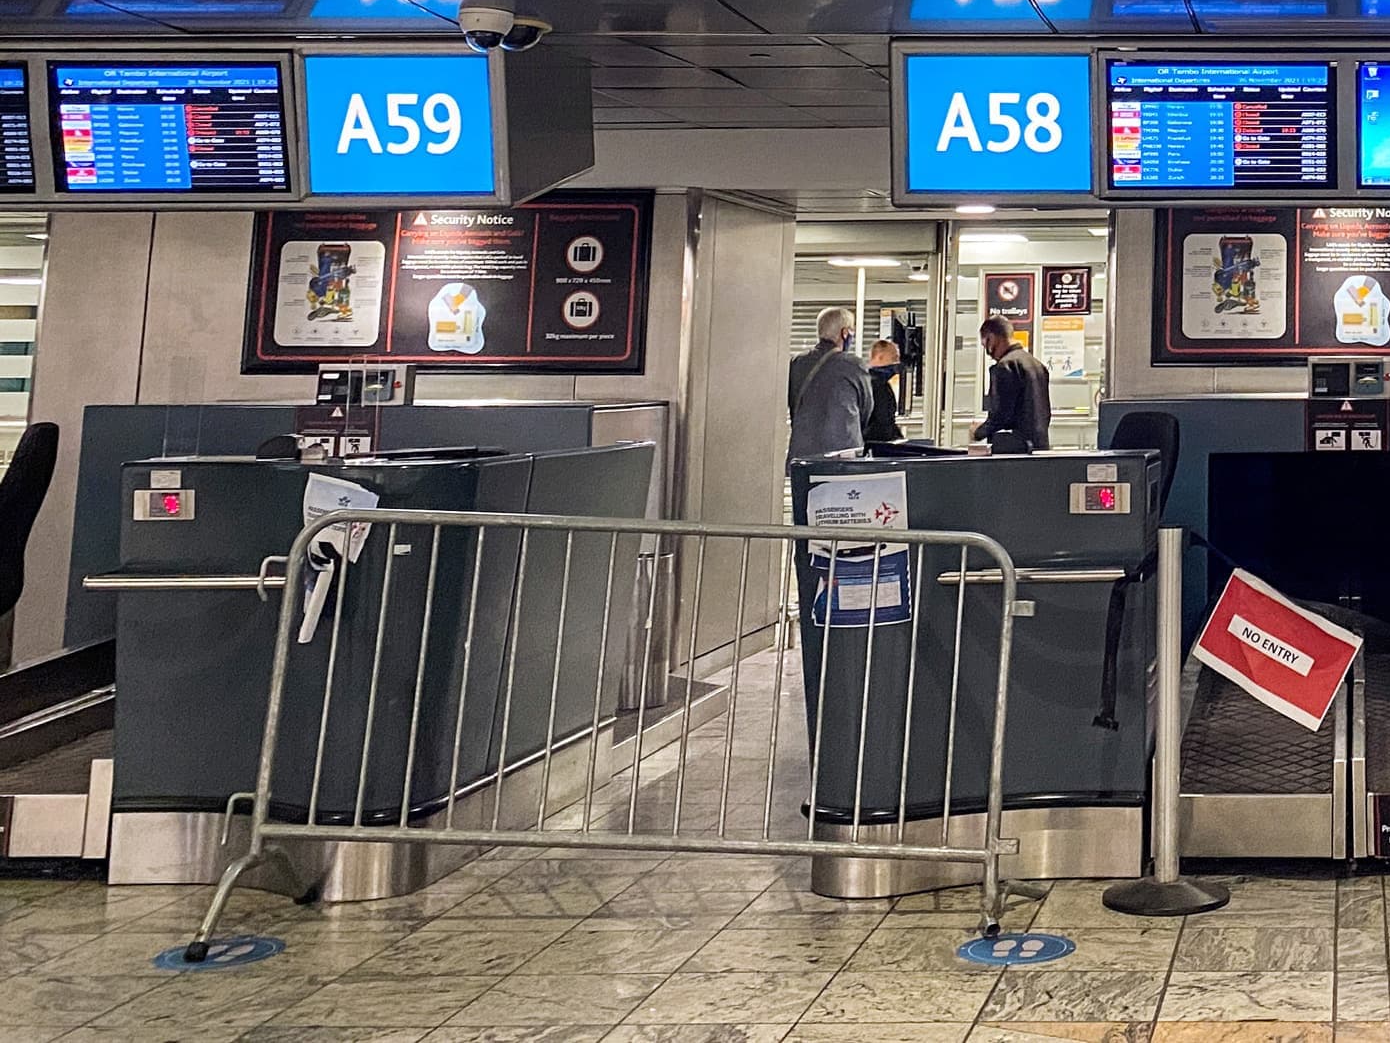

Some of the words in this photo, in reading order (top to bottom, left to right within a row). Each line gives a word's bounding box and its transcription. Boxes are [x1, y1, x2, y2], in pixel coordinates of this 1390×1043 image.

[338, 93, 461, 154] A59
[937, 93, 1062, 152] A58
[430, 215, 474, 227] Security
[477, 215, 514, 225] Notice
[1330, 208, 1374, 220] Security
[990, 307, 1000, 315] No
[1002, 307, 1028, 316] trolleys
[1242, 627, 1261, 643] NO
[1262, 639, 1299, 664] ENTRY
